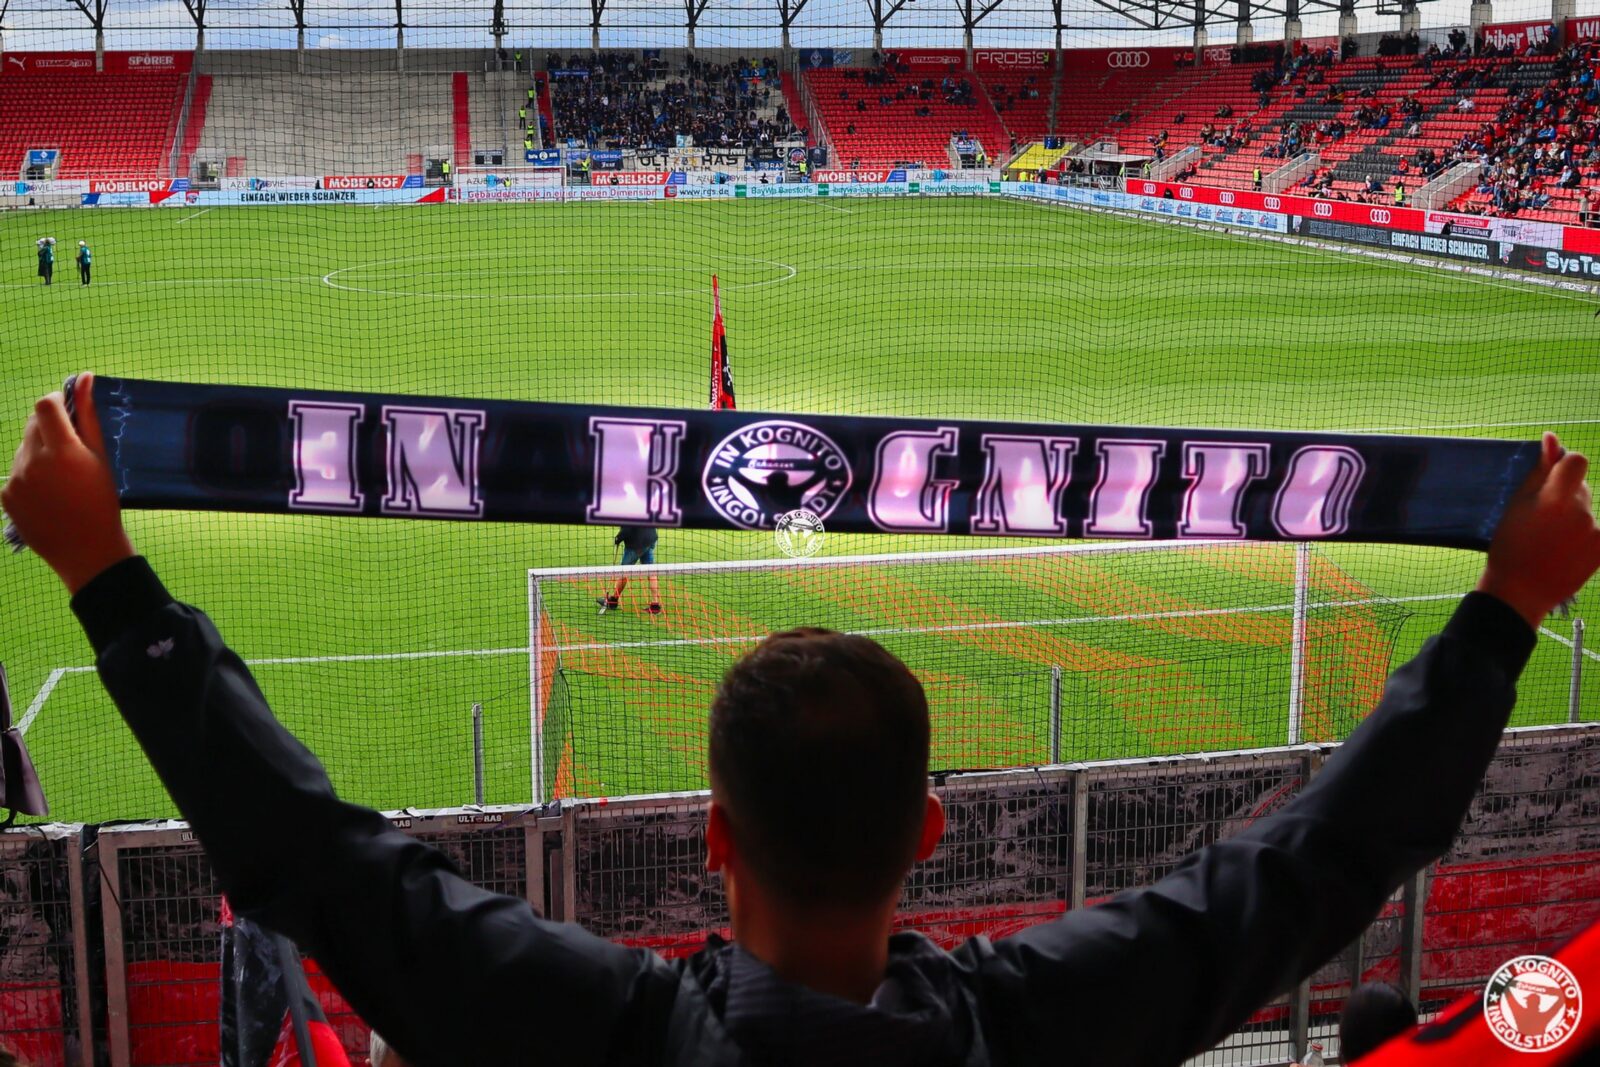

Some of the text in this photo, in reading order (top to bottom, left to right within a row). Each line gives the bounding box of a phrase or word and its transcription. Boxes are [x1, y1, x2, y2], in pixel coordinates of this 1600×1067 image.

[1204, 47, 1233, 61] PROS
[328, 177, 399, 188] MÖBEHOF
[818, 172, 883, 182] MÖBEHOF
[1392, 232, 1419, 250] EINFACH
[1420, 236, 1447, 254] WIEDER
[714, 427, 841, 470] IN KOGNITO
[710, 485, 837, 529] INGOLDT
